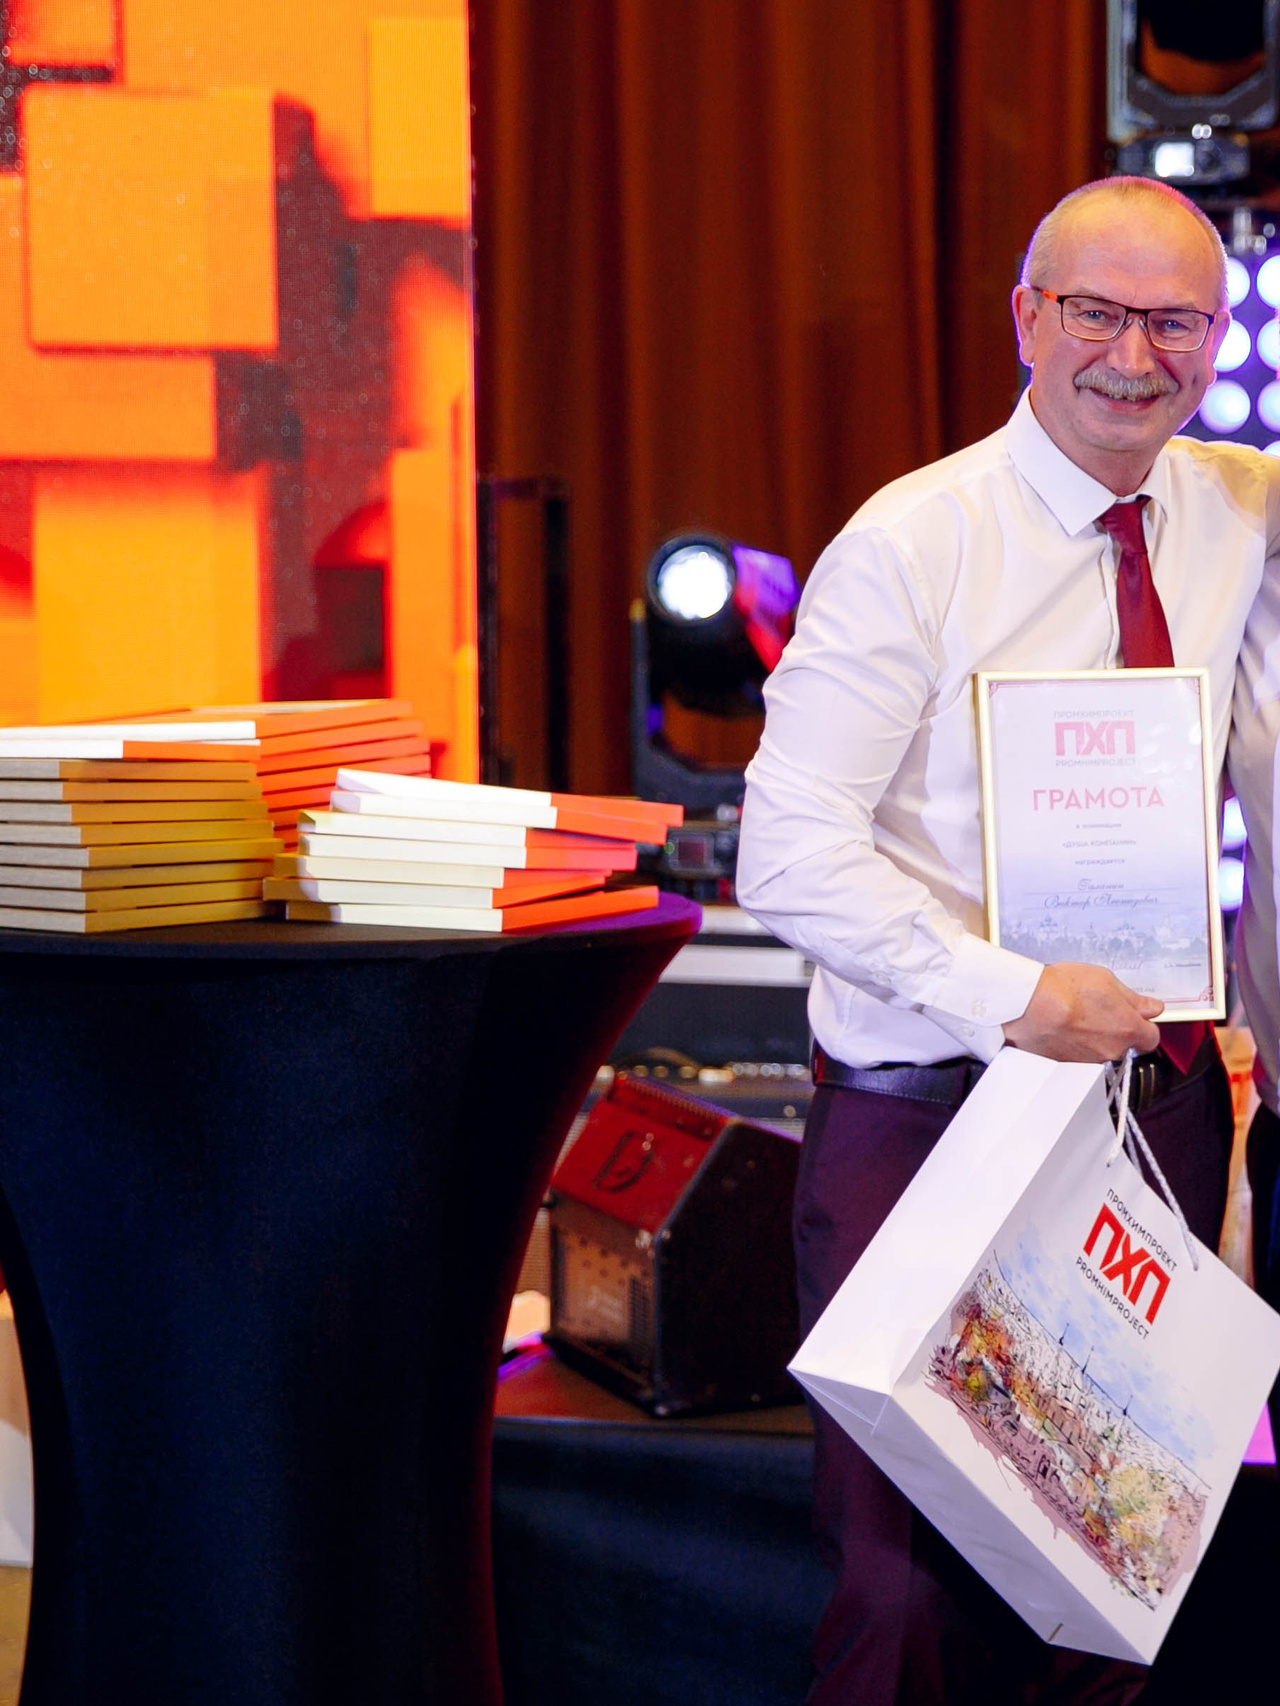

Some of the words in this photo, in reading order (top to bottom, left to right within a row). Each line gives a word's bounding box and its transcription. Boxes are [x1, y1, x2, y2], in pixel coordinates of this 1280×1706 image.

[1054, 720, 1136, 757] ПХП
[1032, 786, 1166, 811] ГРАМОТА
[1083, 1202, 1171, 1326] ПХП
[1106, 1188, 1178, 1272] ПРОМХИМПРОЕКТ
[1076, 1256, 1150, 1340] PROMHIMPROJECT
